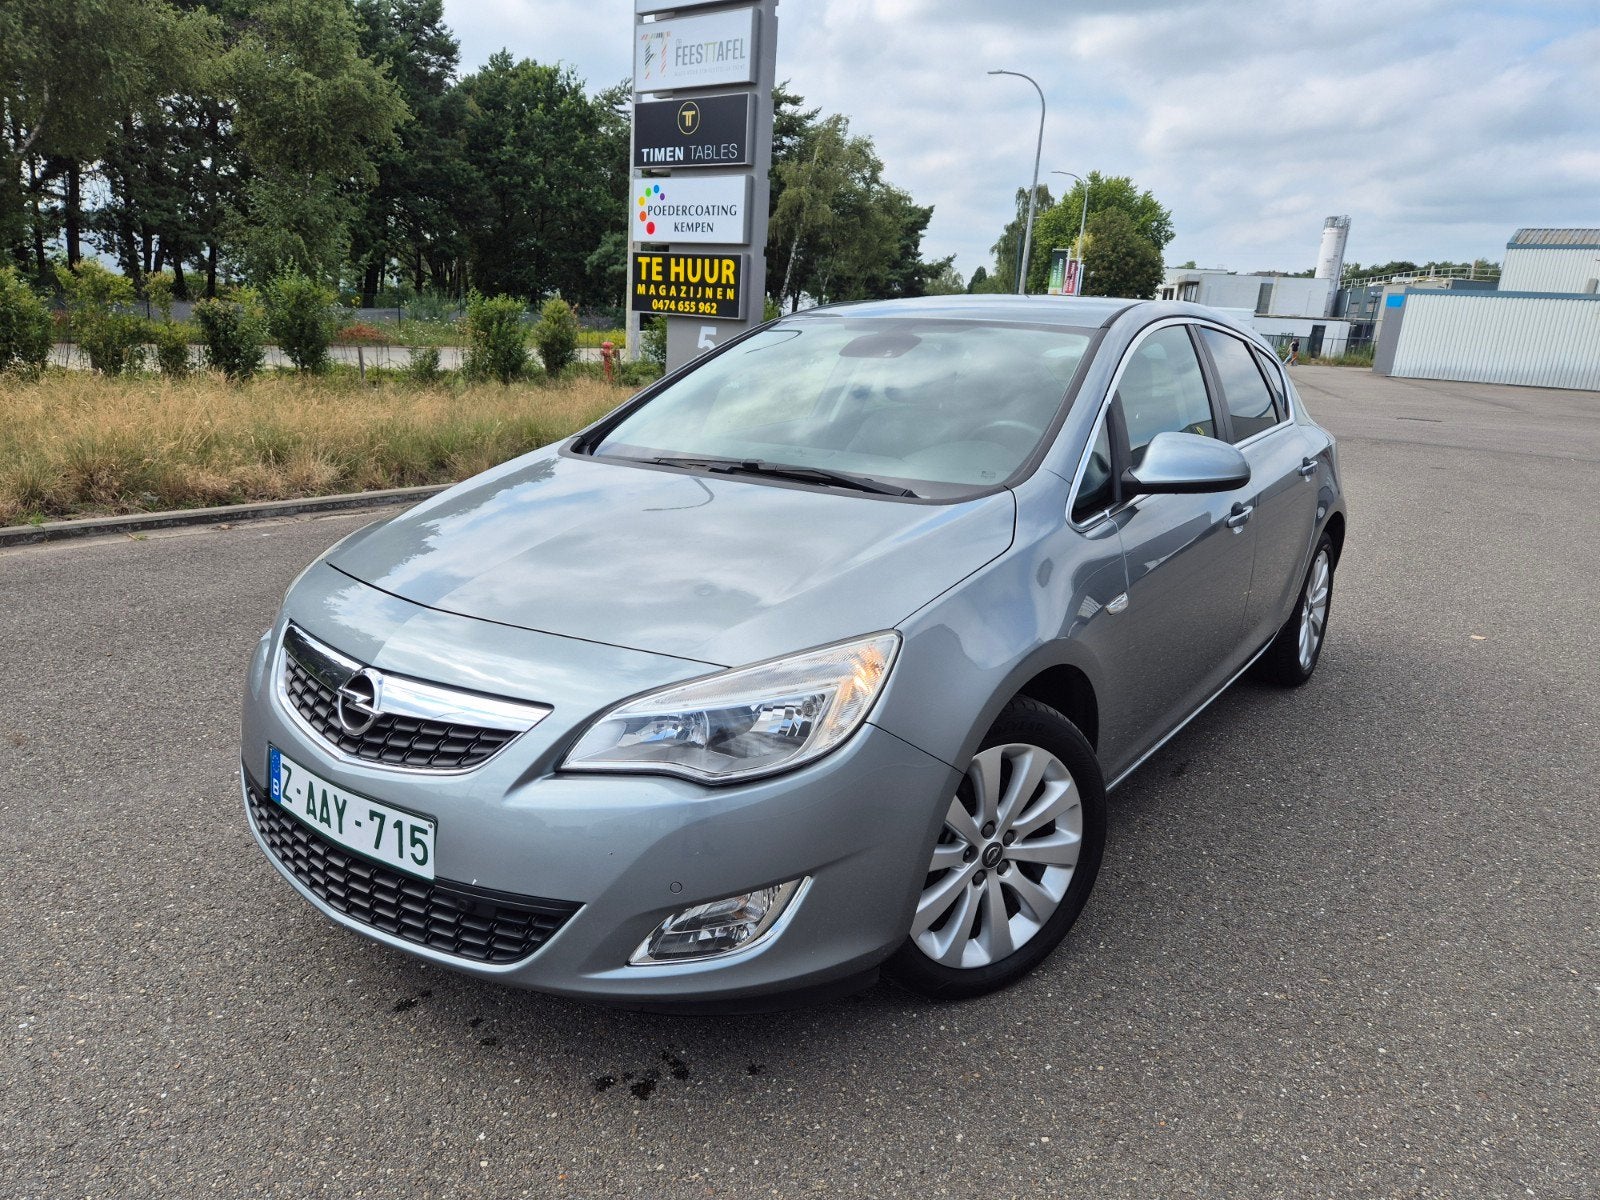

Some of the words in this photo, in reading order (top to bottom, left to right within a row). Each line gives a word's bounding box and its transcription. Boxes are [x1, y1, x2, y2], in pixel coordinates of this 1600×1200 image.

[675, 38, 746, 67] FEESTTAFEL
[641, 146, 684, 162] TIMEN
[689, 143, 738, 160] TABLES
[647, 204, 737, 217] POEDERCOATING
[673, 221, 714, 233] KEMPEN
[637, 256, 663, 281] TE
[670, 257, 736, 285] HUUR
[637, 283, 735, 300] MAGAZIJNEN
[652, 299, 676, 311] 0474
[677, 300, 696, 313] 655
[698, 301, 718, 315] 962
[281, 762, 429, 867] Z-AAY-715
